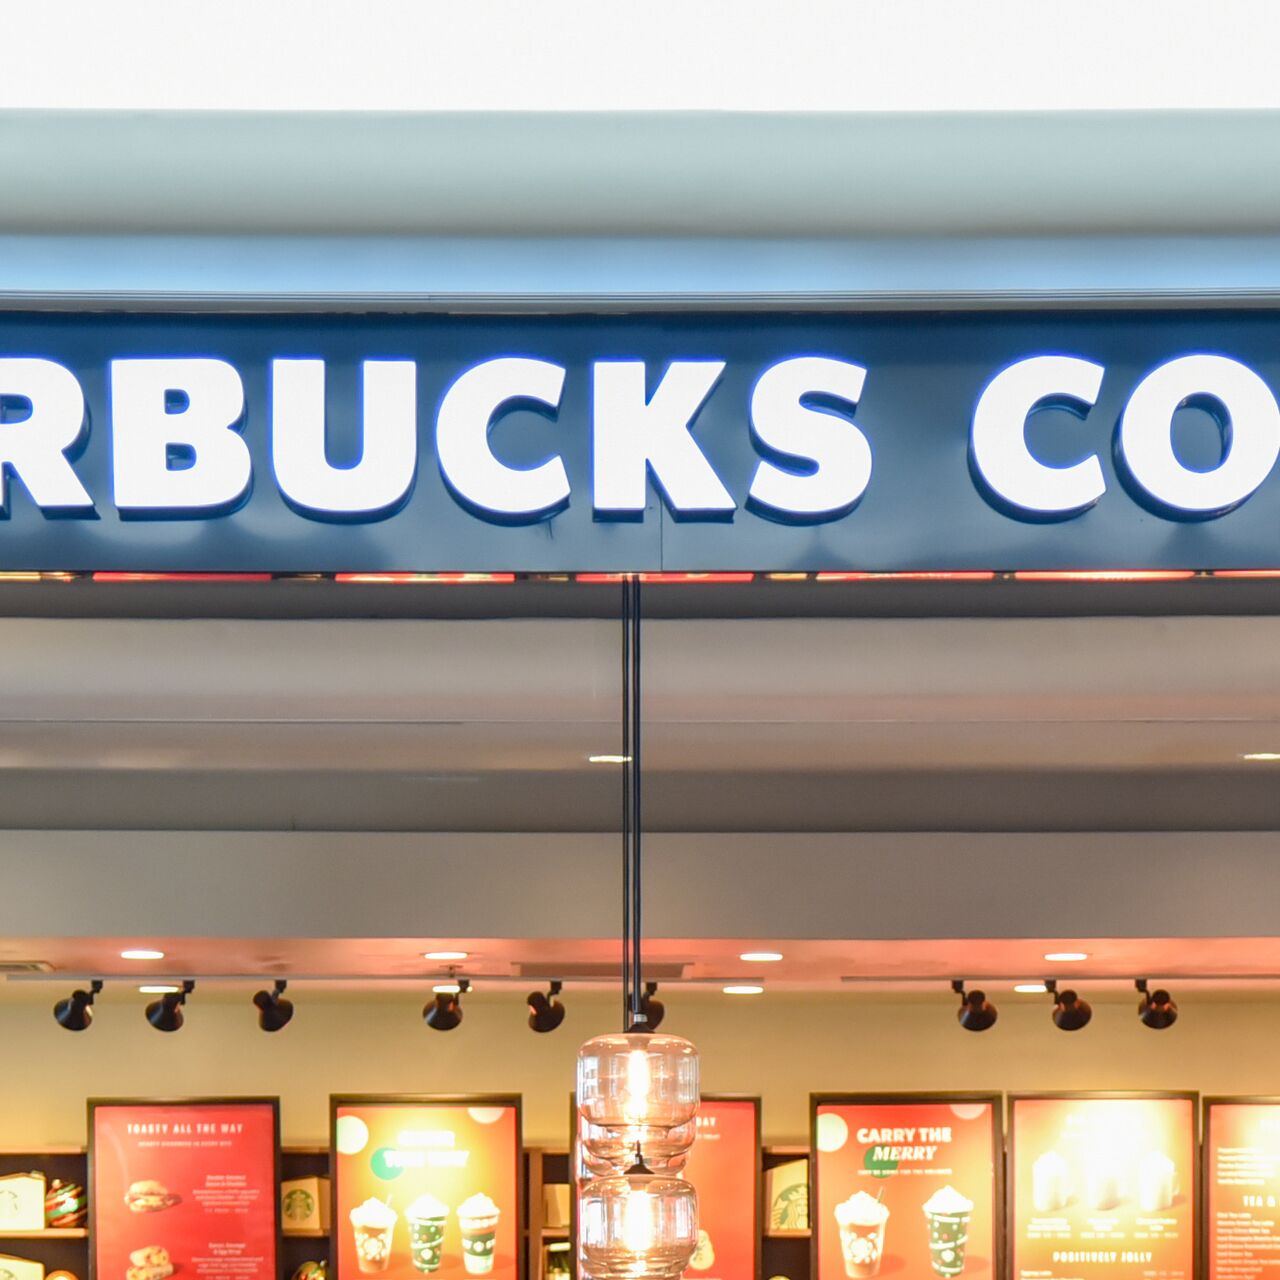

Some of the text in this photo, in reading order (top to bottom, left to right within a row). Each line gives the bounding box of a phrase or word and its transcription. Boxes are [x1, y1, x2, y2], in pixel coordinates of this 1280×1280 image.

[127, 1123, 244, 1134] TOASTY ALL THE WAY
[856, 1126, 953, 1144] CARRY THE
[872, 1145, 938, 1162] MERRY
[1243, 1195, 1264, 1208] TEA
[1052, 1251, 1153, 1263] POSITIVELY JOLLY
